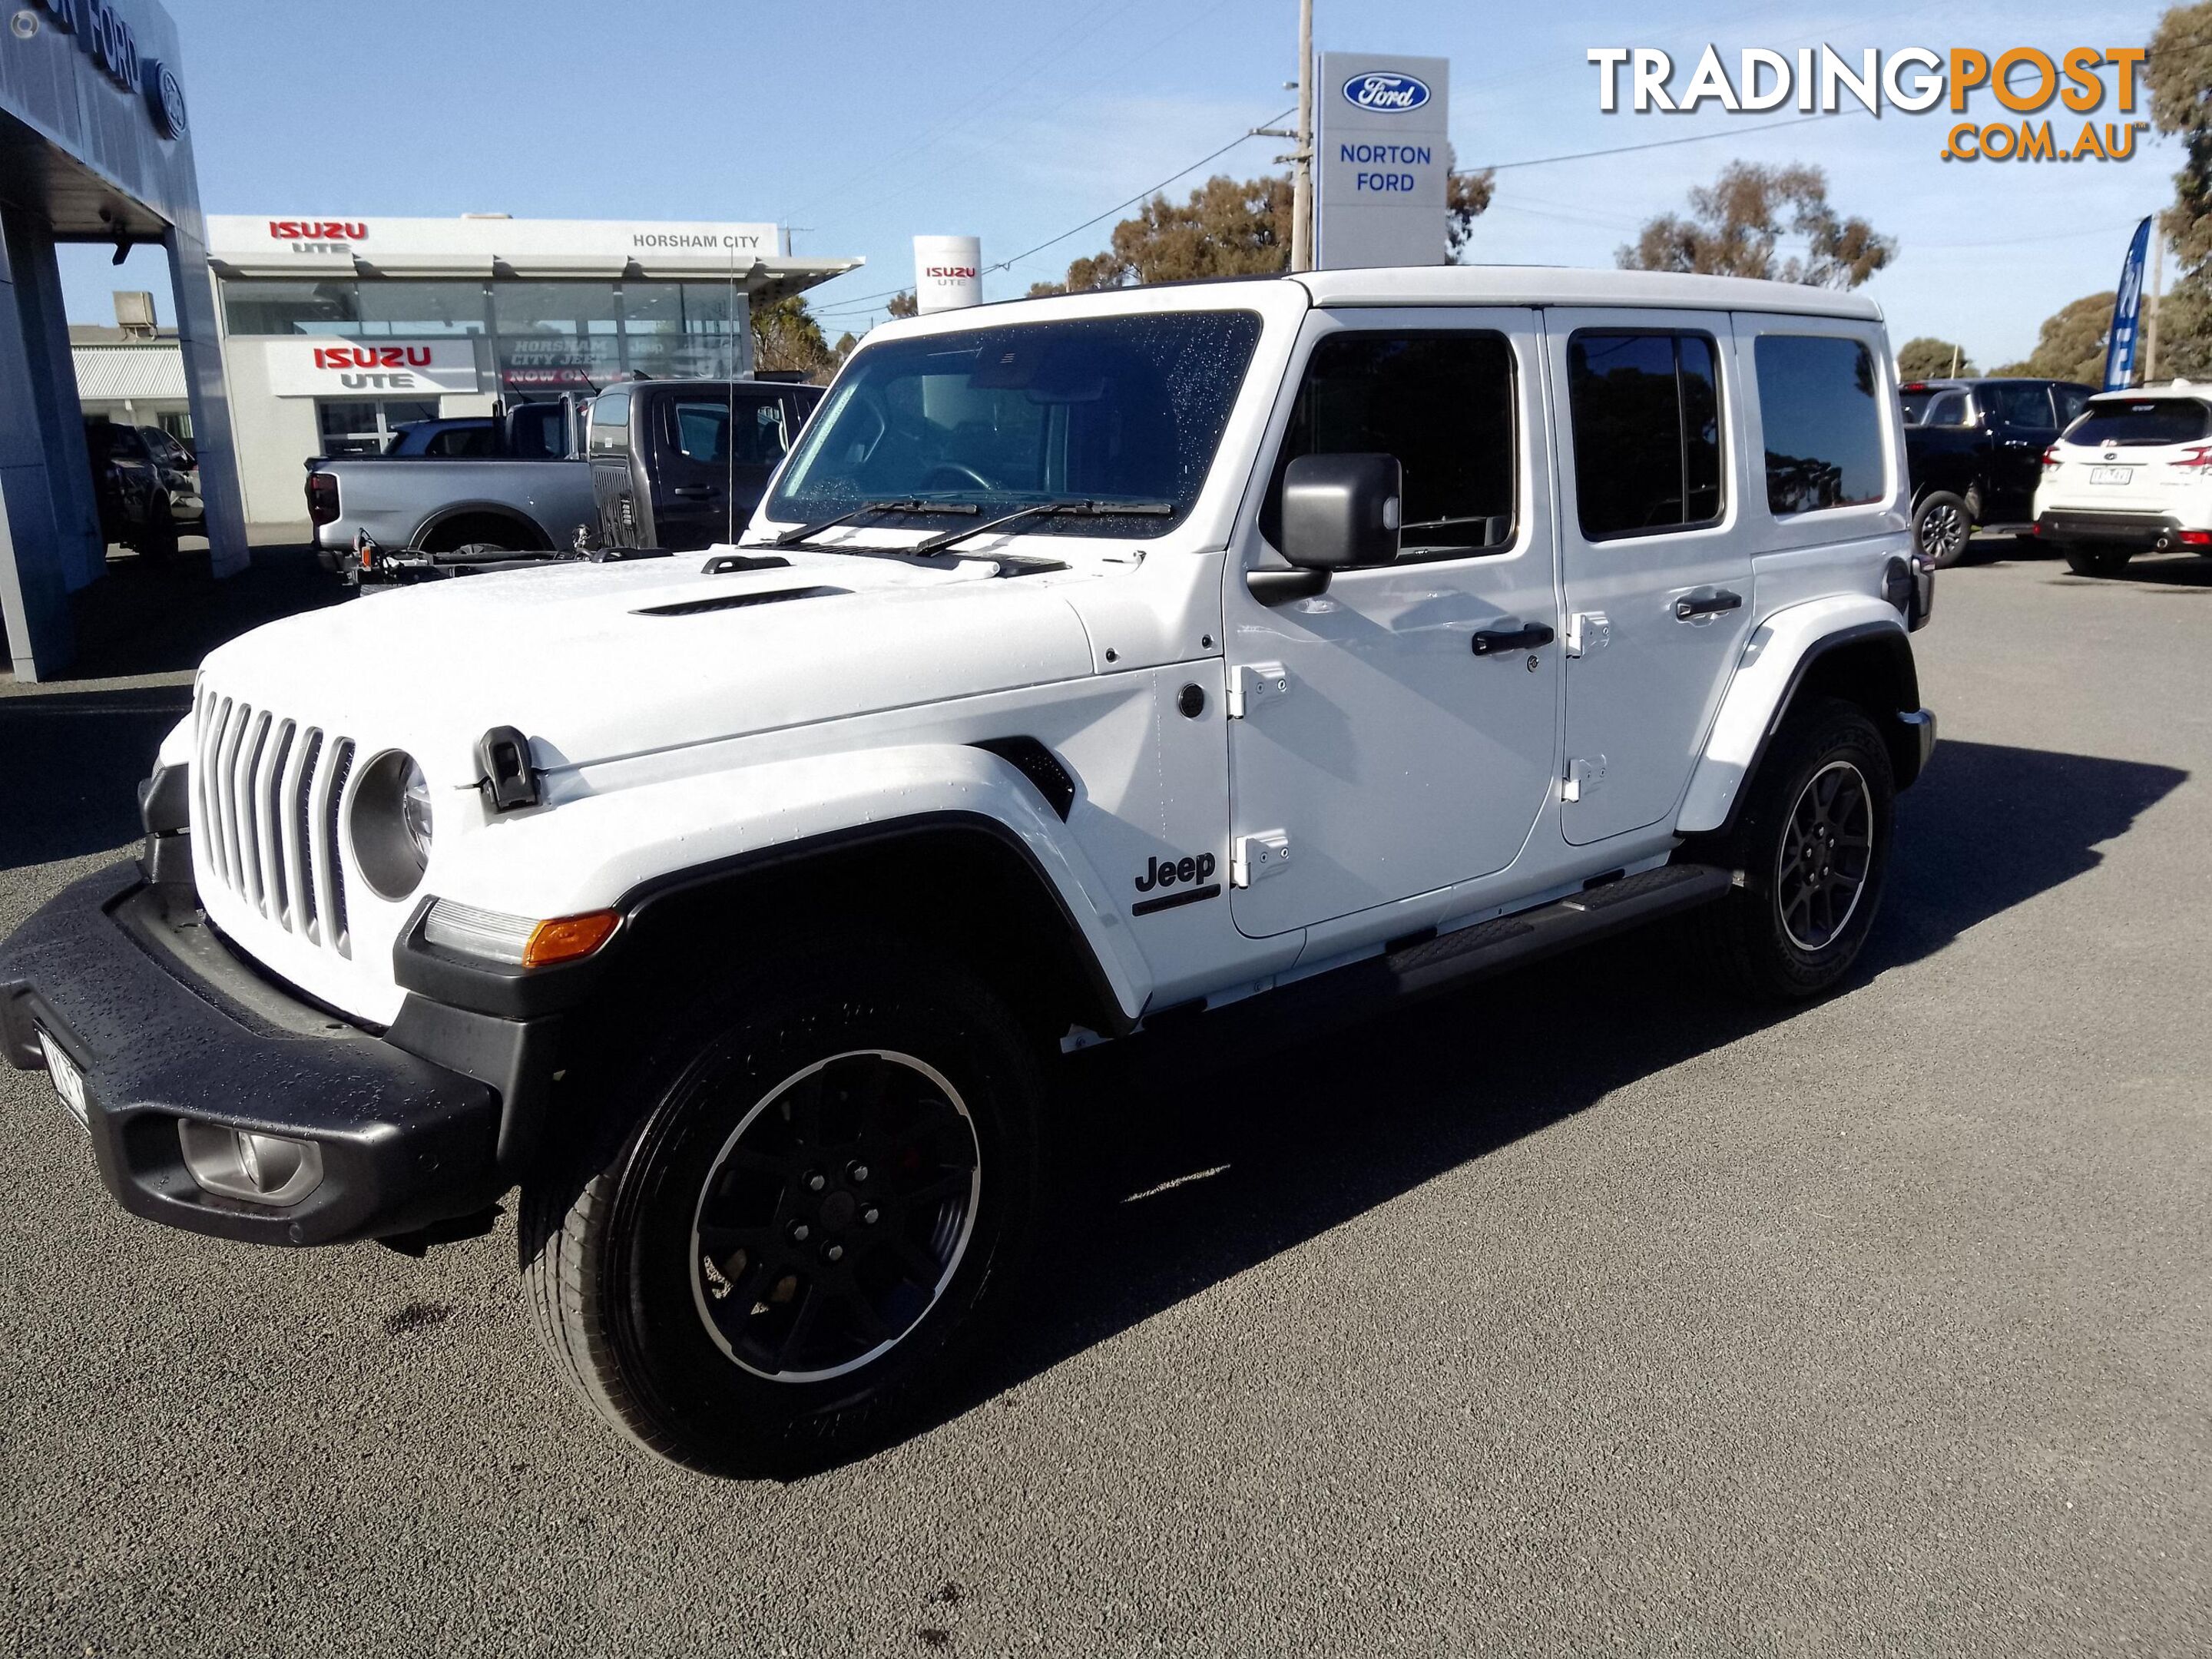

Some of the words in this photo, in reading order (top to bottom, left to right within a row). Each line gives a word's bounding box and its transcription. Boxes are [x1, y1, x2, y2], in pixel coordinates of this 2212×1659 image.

[1358, 77, 1416, 107] Ford
[1341, 144, 1431, 164] NORTON
[1357, 173, 1414, 191] FORD
[270, 221, 366, 240] ISUZU
[292, 243, 352, 253] UTE
[634, 234, 717, 248] HORSHAM
[724, 236, 759, 248] CITY
[926, 267, 975, 277] ISUZU
[515, 340, 608, 353] HORSHAM
[313, 346, 432, 369] ISUZU
[511, 354, 555, 365] CITY
[340, 373, 416, 389] UTE
[510, 369, 558, 382] NOW
[1134, 852, 1216, 892] Jeep
